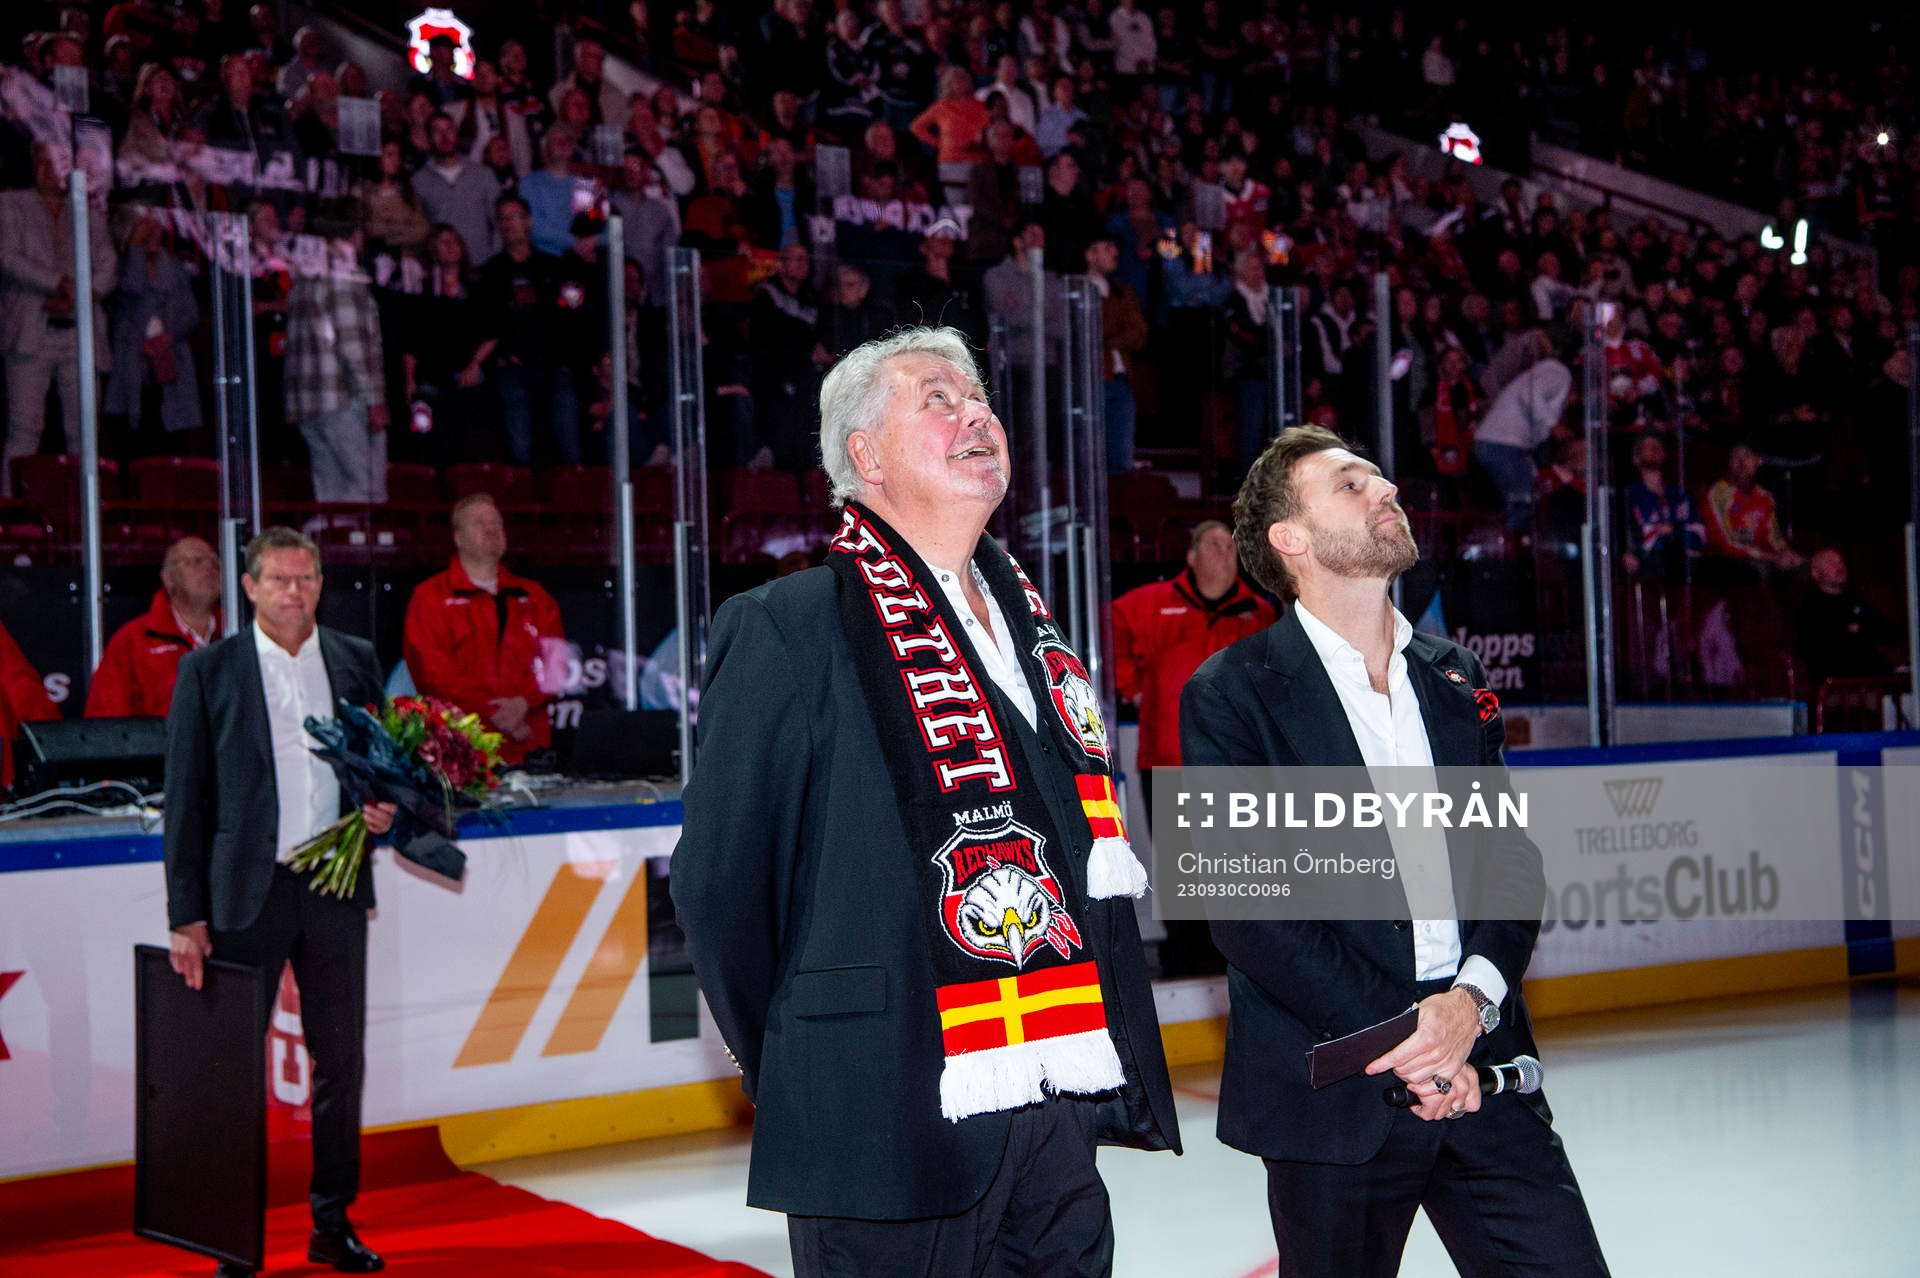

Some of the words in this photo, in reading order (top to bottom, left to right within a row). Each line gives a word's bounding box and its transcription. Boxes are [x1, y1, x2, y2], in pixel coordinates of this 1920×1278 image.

[952, 800, 1014, 827] MALMÖ
[1574, 820, 1698, 855] TRELLEBORG
[951, 837, 1038, 887] REDHAWKS
[1850, 769, 1876, 919] CCM
[1541, 850, 1780, 934] ortsClub
